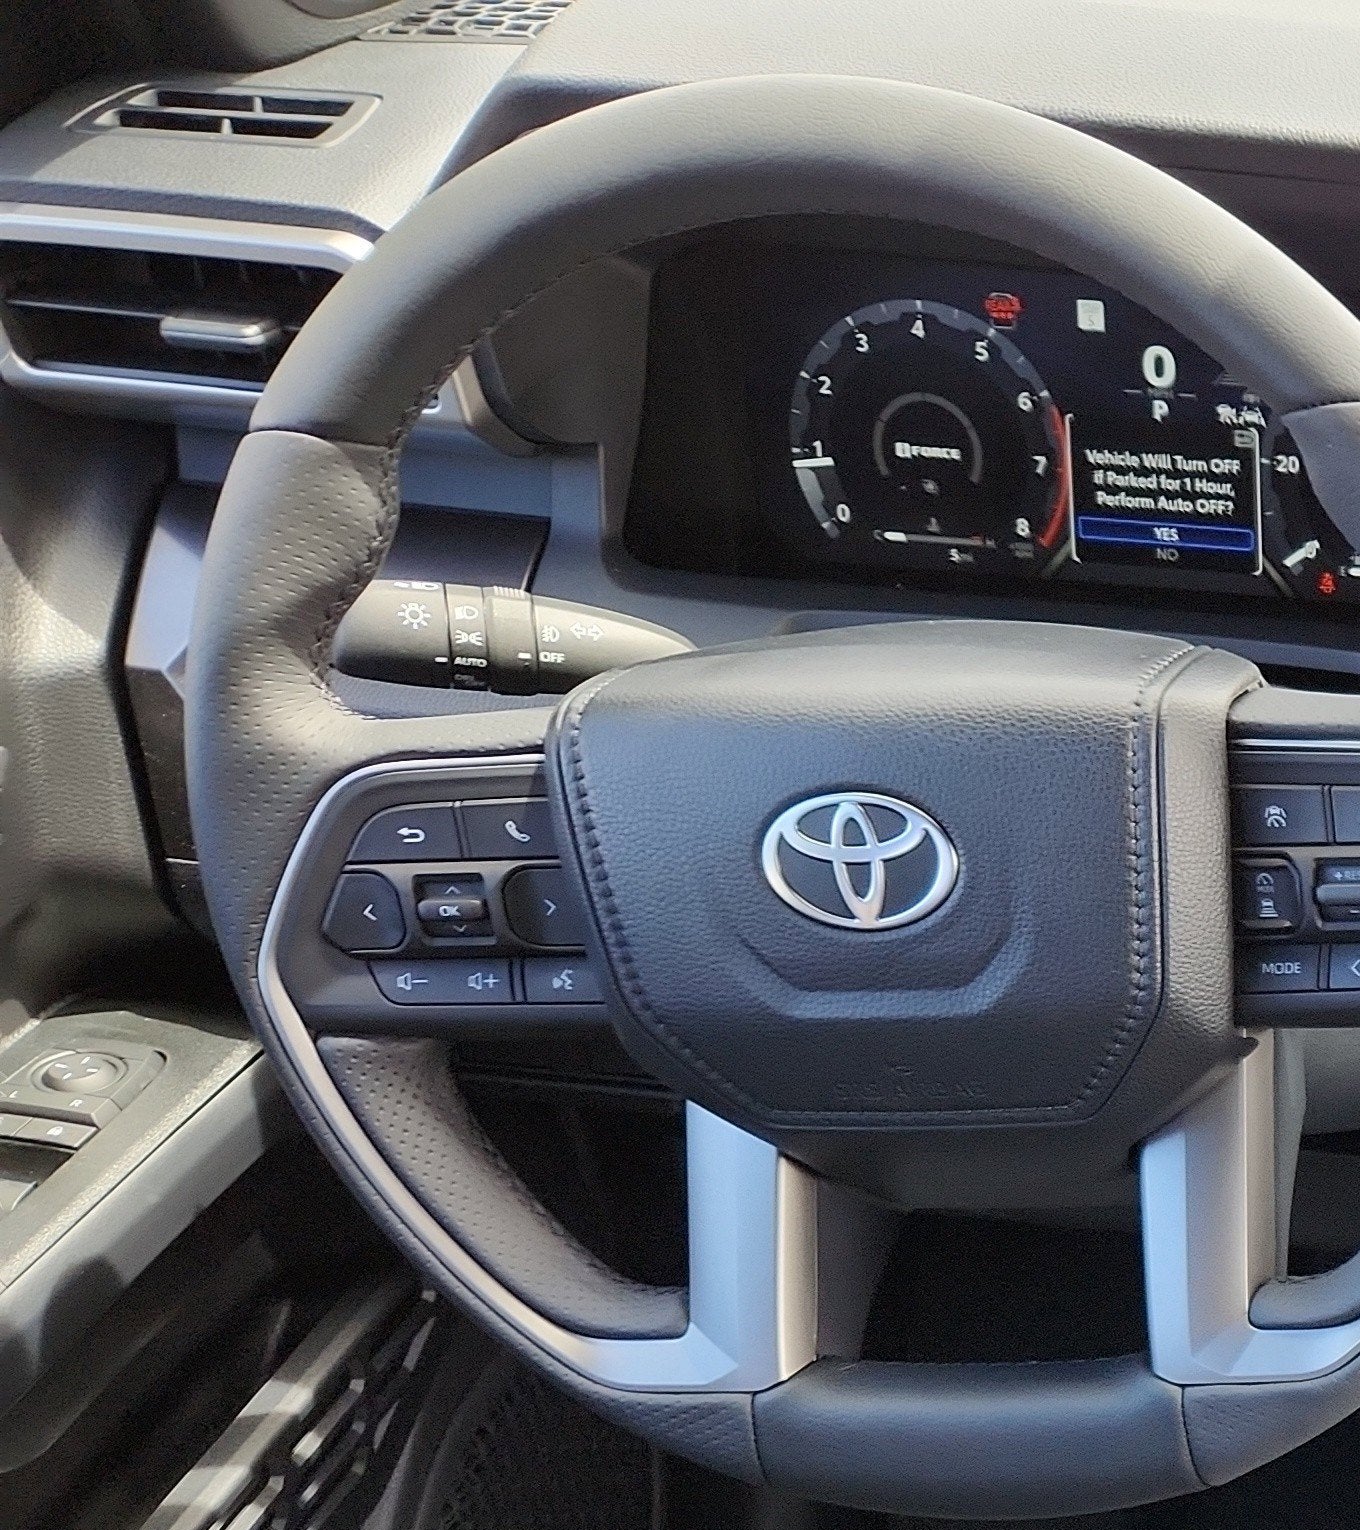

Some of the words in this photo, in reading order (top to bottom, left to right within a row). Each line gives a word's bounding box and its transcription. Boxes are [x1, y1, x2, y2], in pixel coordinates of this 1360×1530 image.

[910, 319, 926, 339] 4
[855, 333, 870, 353] 3
[973, 342, 990, 362] 5
[1141, 344, 1177, 389] 0
[818, 375, 833, 395] 2
[1017, 392, 1033, 412] 6
[1153, 400, 1169, 423] P
[813, 440, 825, 457] 1
[1032, 455, 1048, 477] 7
[1084, 448, 1140, 467] Vehicle
[1141, 452, 1174, 472] Will
[1174, 455, 1208, 473] Turn
[1210, 457, 1241, 475] OFF
[1276, 455, 1299, 473] 20
[1106, 471, 1158, 490] Parked
[1160, 474, 1181, 491] for
[1095, 490, 1156, 509] Perform
[1158, 495, 1193, 512] Auto
[1196, 498, 1235, 516] OFF?
[836, 504, 851, 523] 0
[1015, 517, 1031, 538] 8
[1153, 526, 1180, 542] YES
[1156, 547, 1180, 561] NO
[453, 656, 488, 668] AUTO
[539, 651, 565, 663] OFF
[439, 905, 461, 918] OK
[1262, 962, 1302, 975] MODE
